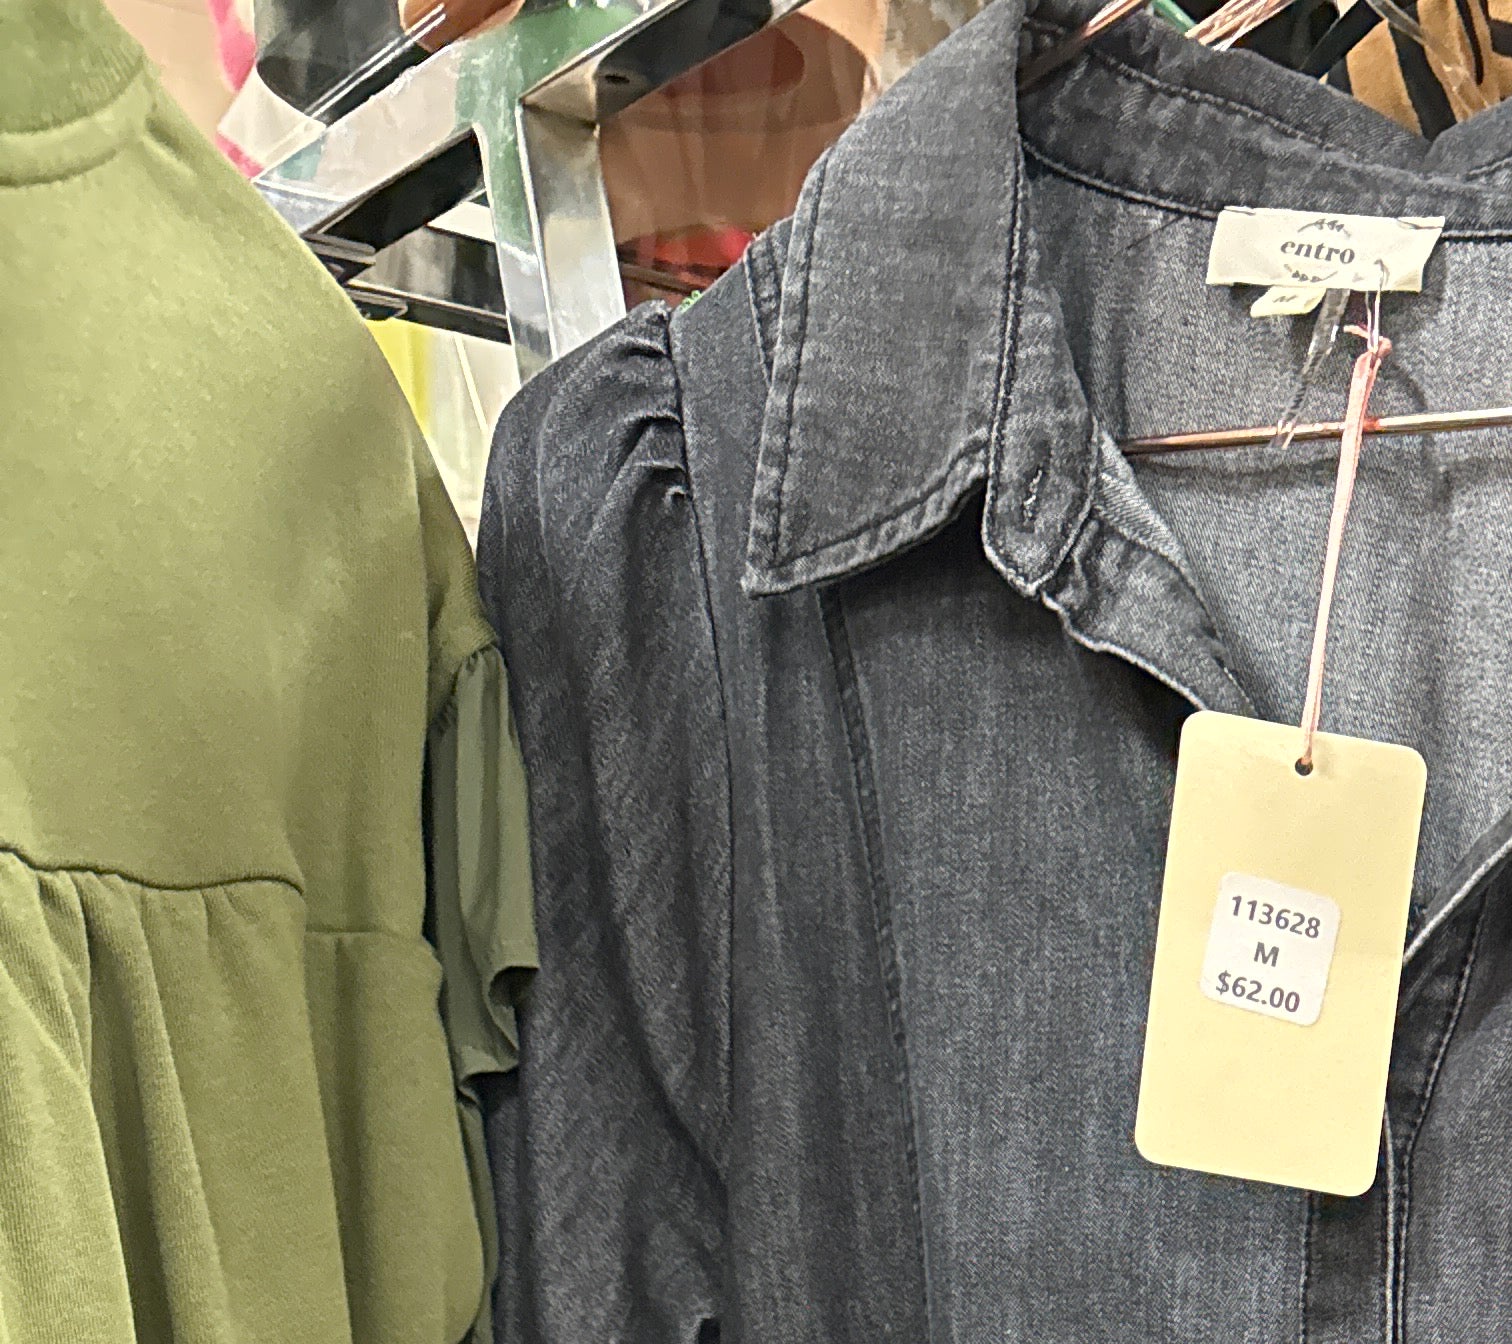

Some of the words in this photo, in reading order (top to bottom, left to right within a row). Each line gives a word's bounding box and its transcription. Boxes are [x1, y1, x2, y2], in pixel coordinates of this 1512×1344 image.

[1280, 240, 1356, 265] entro
[1231, 895, 1321, 939] 113628
[1253, 941, 1280, 967] M
[1215, 969, 1301, 1013] $62.00
